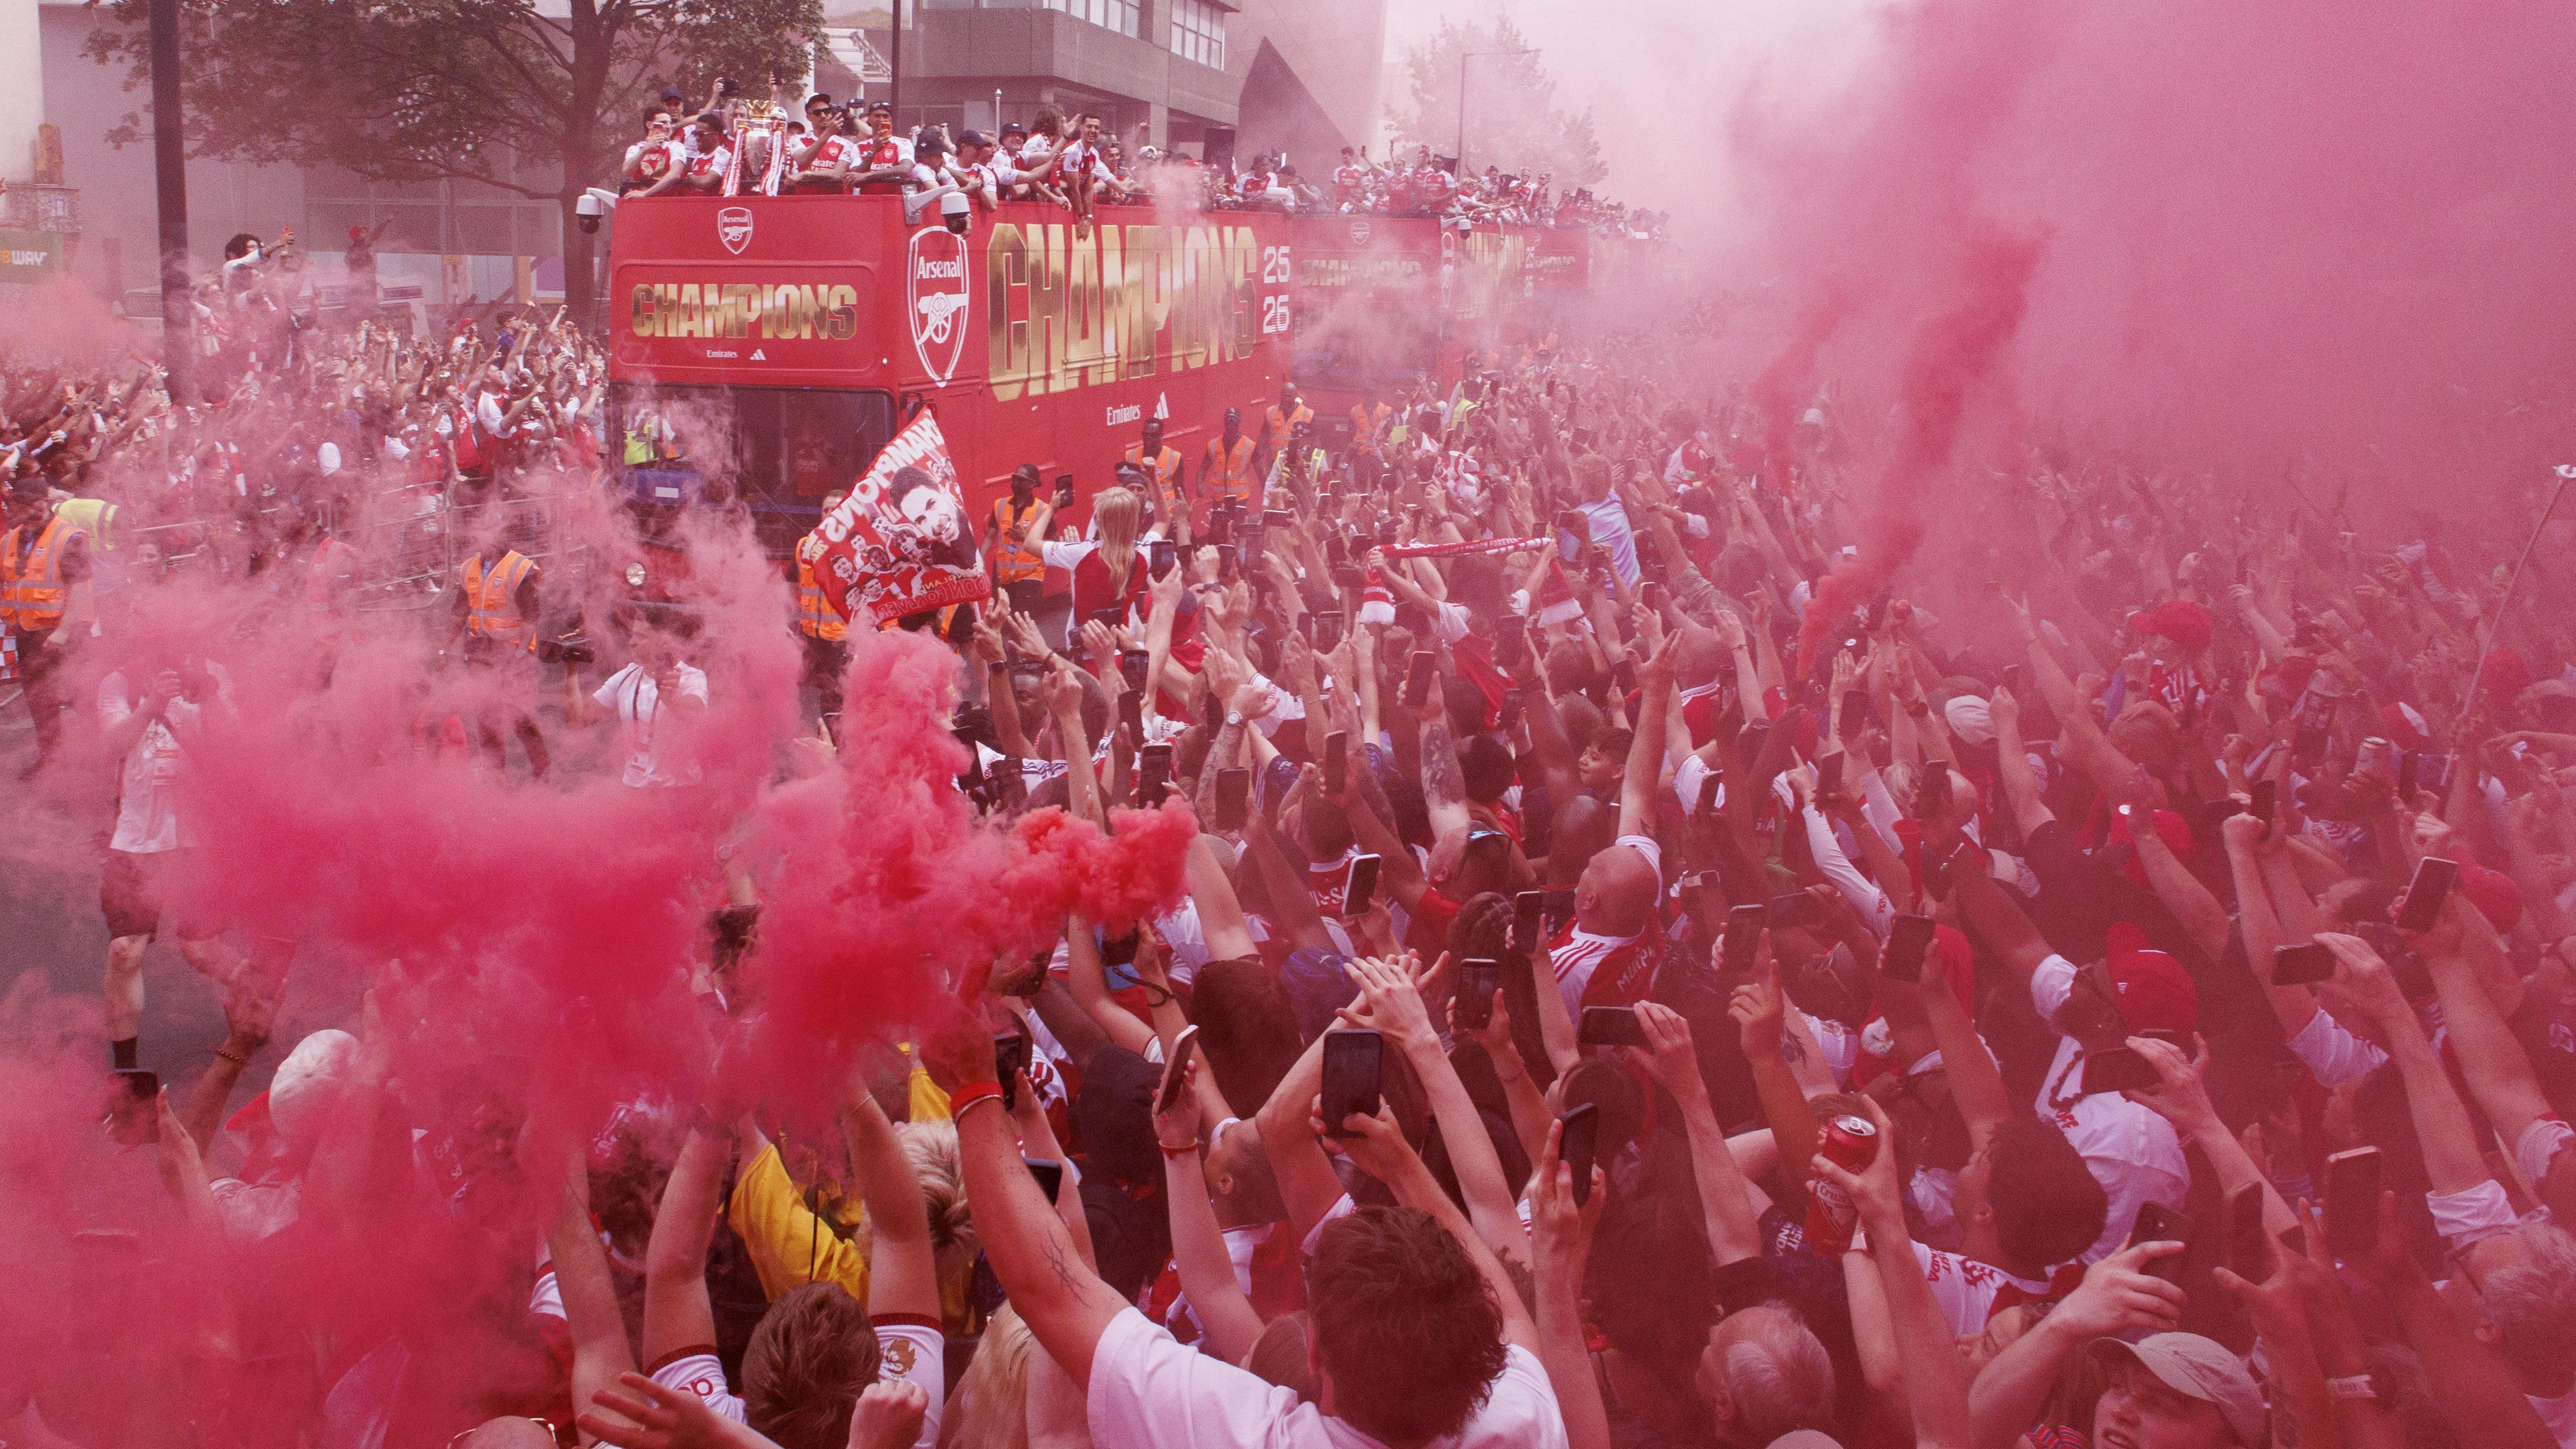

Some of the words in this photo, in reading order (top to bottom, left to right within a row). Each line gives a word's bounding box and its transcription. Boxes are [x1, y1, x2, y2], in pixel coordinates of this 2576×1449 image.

[0, 249, 48, 266] BWAY
[917, 255, 961, 279] Arsenal
[1263, 246, 1290, 283] 25
[632, 283, 858, 340] CHAMPIONS
[987, 222, 1258, 403] CHAMPIONS
[706, 350, 738, 358] Emirates
[1107, 405, 1141, 426] Emirates
